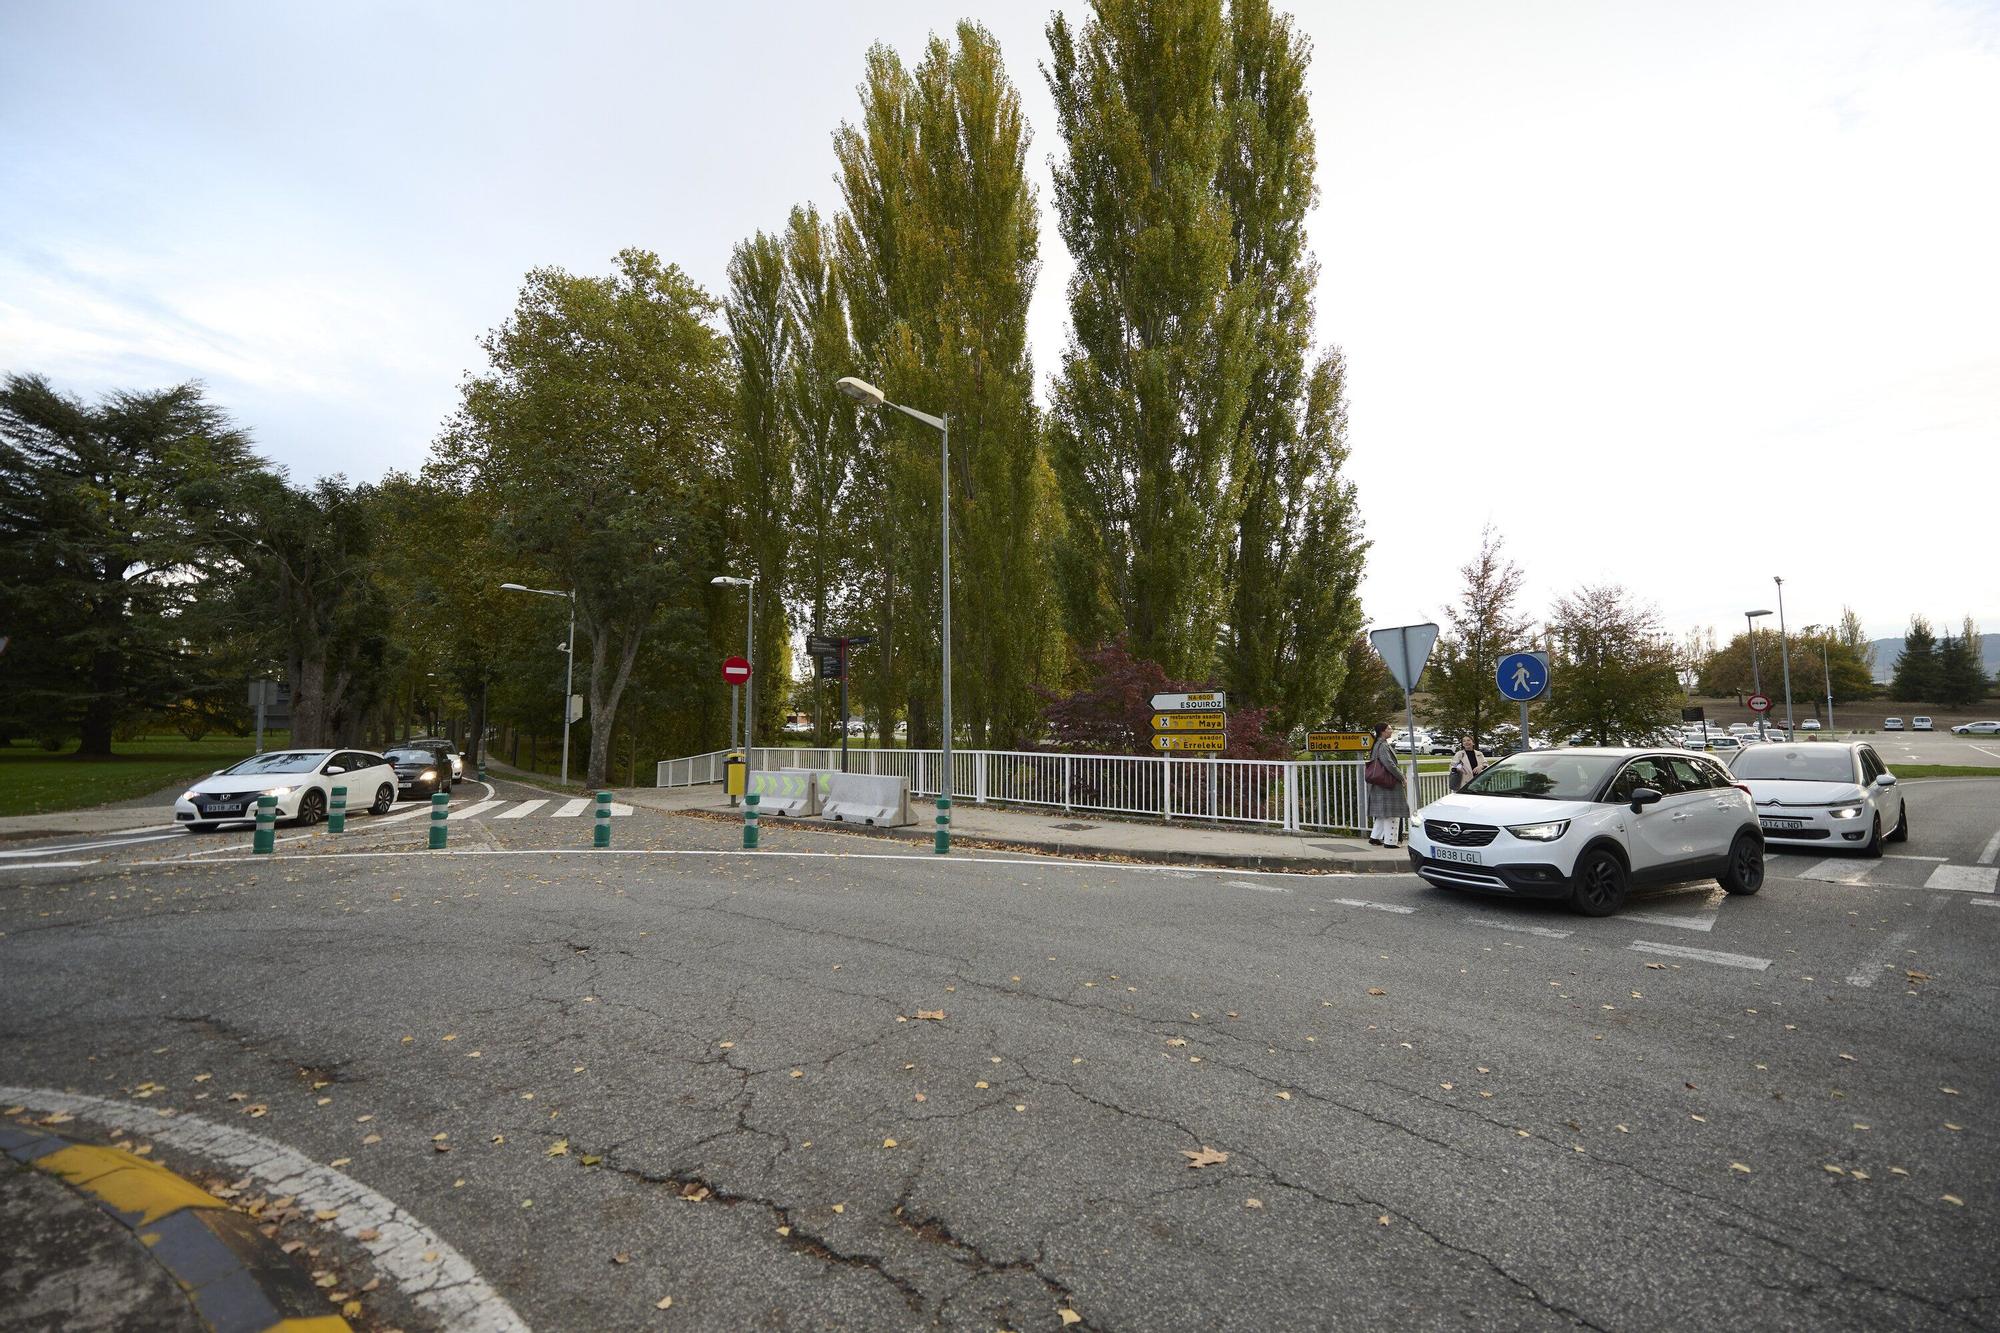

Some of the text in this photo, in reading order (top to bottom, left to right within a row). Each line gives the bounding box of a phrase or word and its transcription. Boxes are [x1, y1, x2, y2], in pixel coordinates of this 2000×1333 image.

[1334, 742, 1339, 750] 2
[1436, 848, 1478, 864] 0838 LGL
